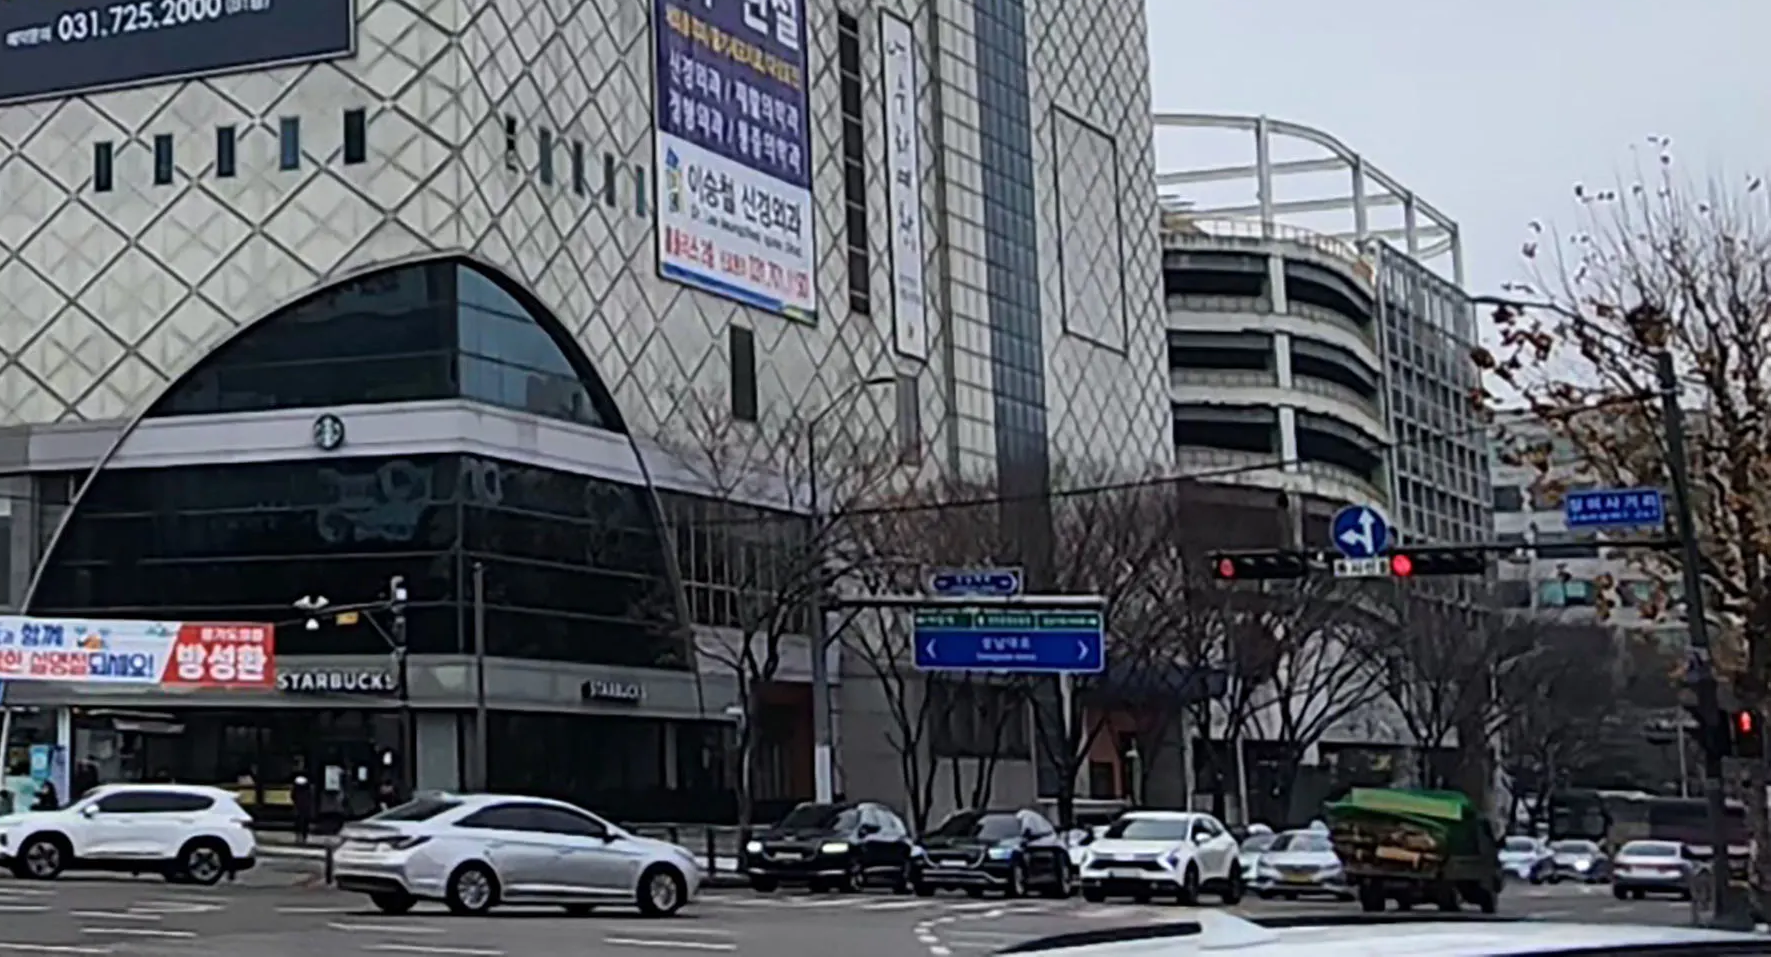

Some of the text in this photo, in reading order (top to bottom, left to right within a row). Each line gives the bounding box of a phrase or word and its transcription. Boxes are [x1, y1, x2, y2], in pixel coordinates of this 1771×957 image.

[741, 184, 802, 239] 신경외과
[21, 621, 65, 647] 함께
[176, 643, 268, 681] 방성환
